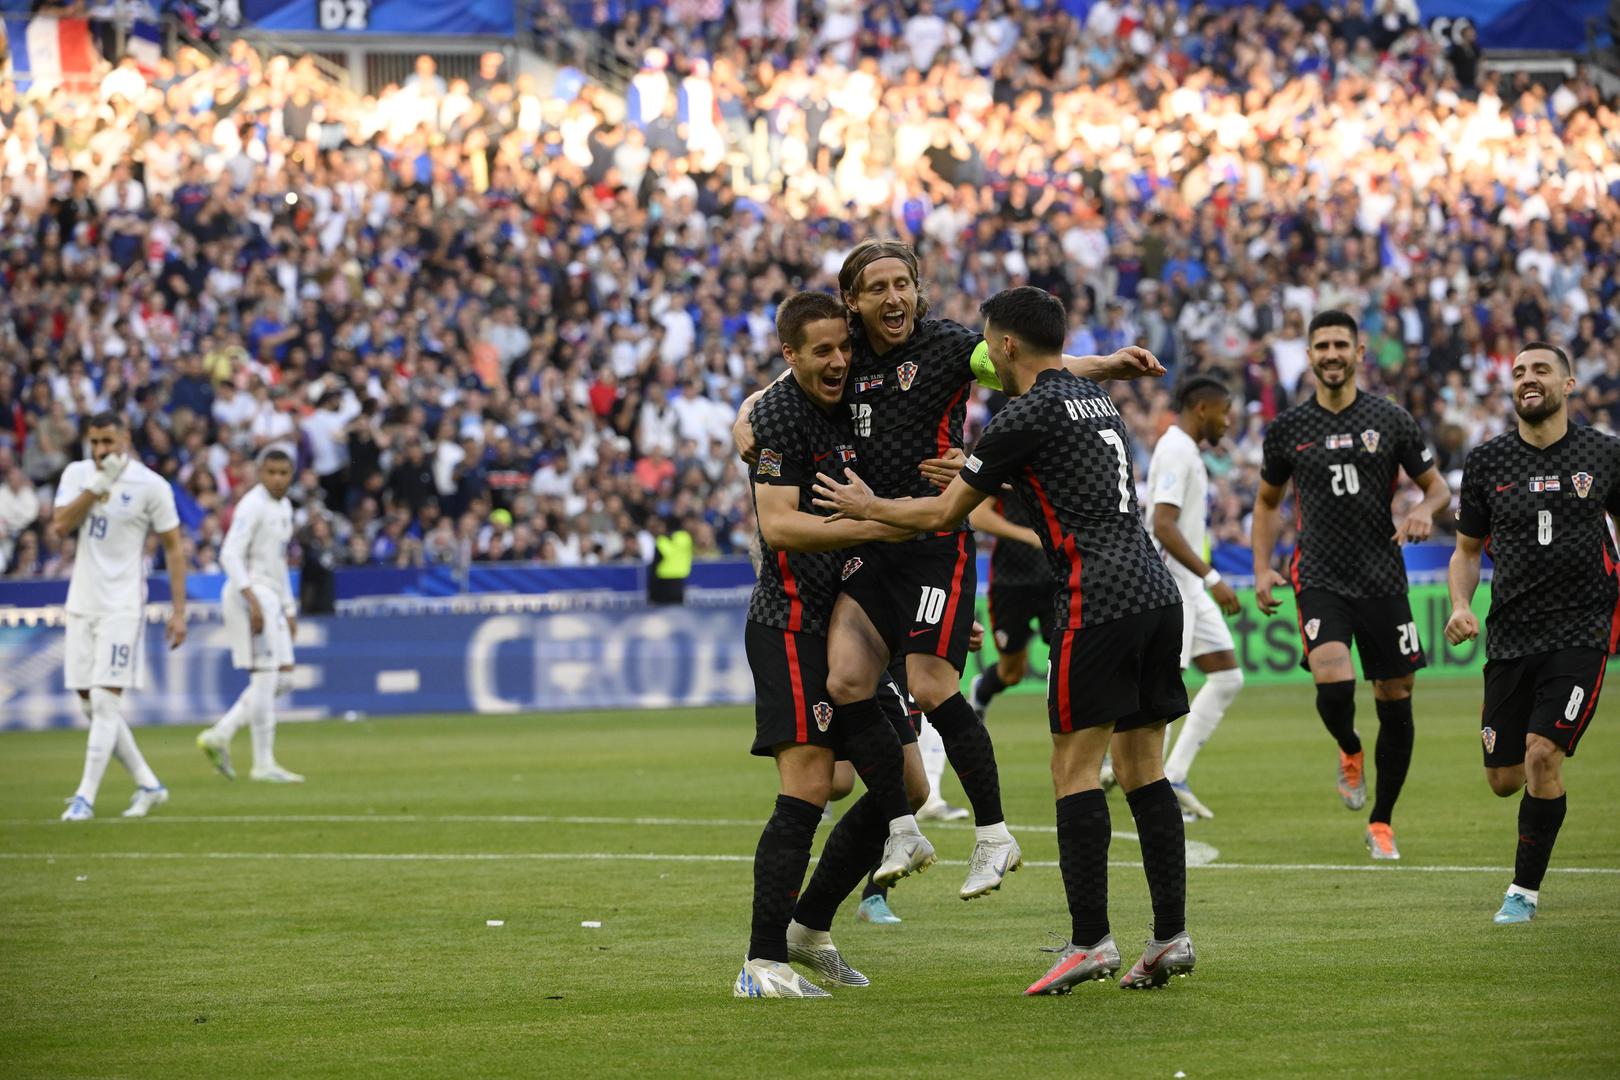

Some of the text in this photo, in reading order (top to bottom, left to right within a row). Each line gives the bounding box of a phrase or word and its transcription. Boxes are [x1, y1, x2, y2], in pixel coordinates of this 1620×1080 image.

[849, 403, 873, 438] 10
[1064, 396, 1120, 420] BREKAL
[1097, 428, 1130, 513] 7
[1328, 463, 1360, 497] 20
[88, 515, 108, 540] 19
[1538, 510, 1552, 546] 8
[916, 585, 947, 625] 10
[110, 642, 131, 669] 19
[1396, 621, 1420, 656] 20
[1564, 685, 1585, 722] 8
